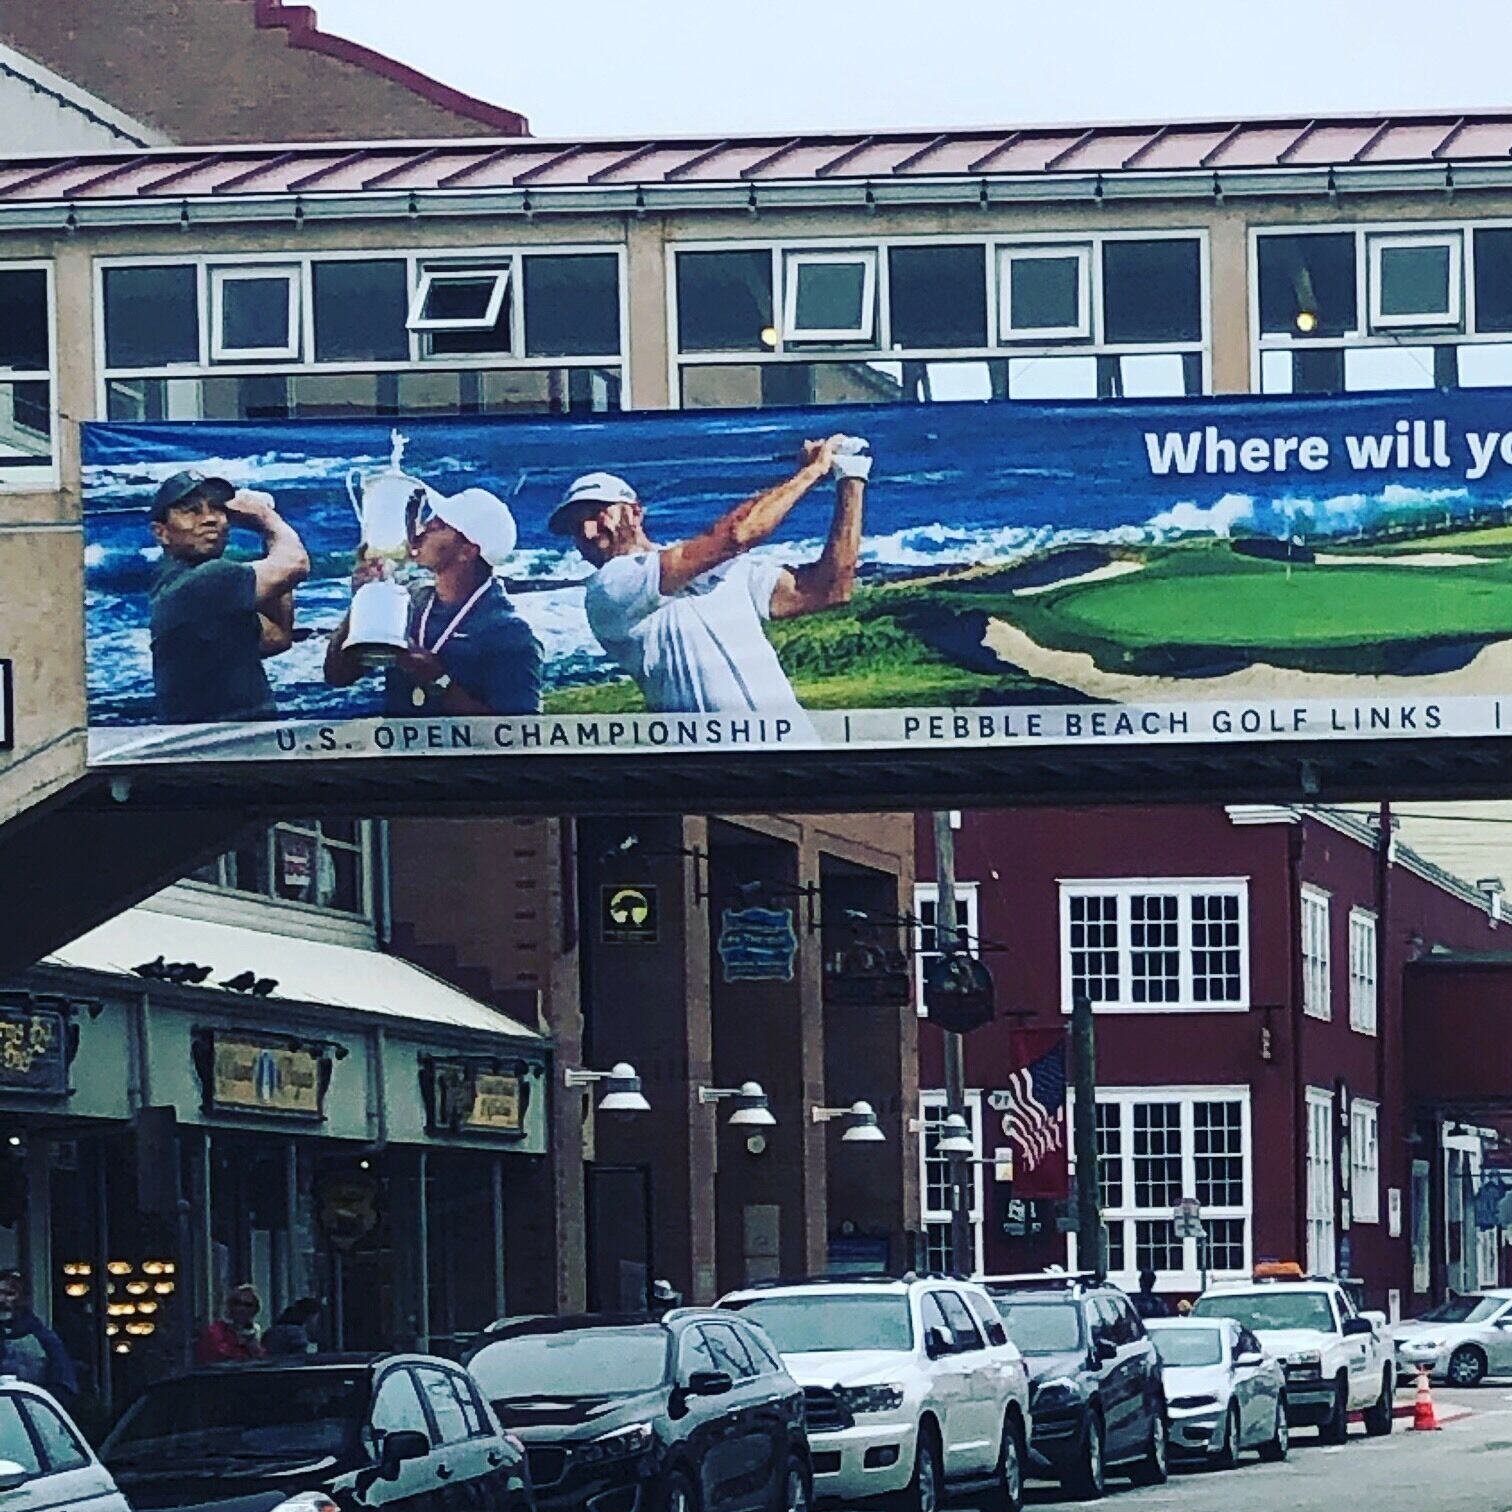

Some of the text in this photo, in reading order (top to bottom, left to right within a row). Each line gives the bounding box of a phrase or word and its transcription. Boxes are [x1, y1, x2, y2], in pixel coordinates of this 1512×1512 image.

[1145, 426, 1329, 474] Where
[1346, 420, 1450, 471] will
[277, 726, 353, 752] U.S.
[374, 724, 472, 749] OPEN
[494, 719, 793, 748] CHAMPIONSHIP
[904, 714, 1043, 740] PEBBLE
[1065, 710, 1189, 737] BEACH
[1212, 708, 1307, 733] GOLF
[1331, 704, 1443, 731] LINKS
